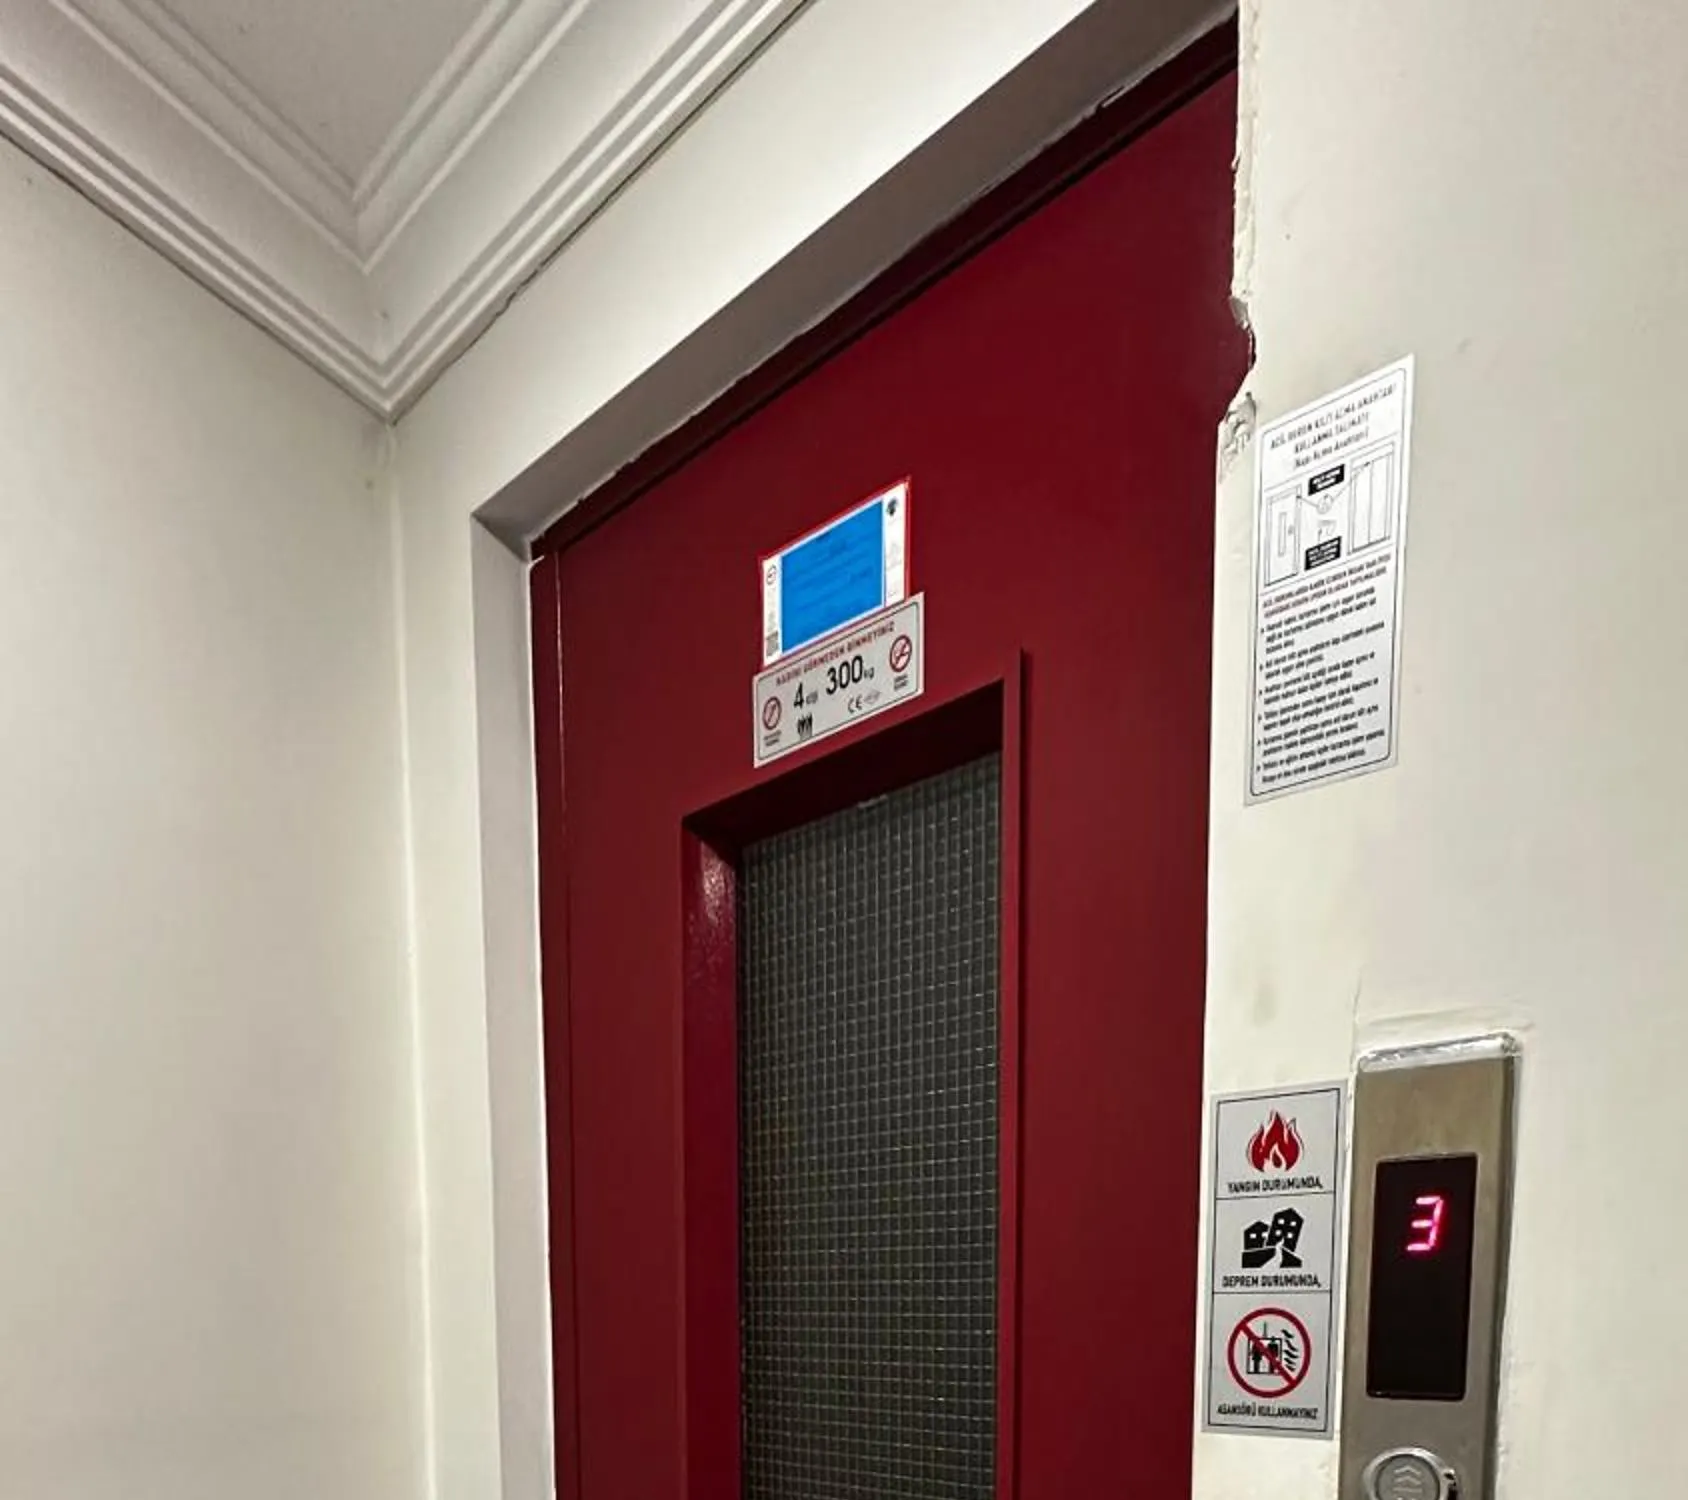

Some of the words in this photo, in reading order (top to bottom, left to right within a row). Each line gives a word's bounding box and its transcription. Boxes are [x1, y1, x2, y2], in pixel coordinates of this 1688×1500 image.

[793, 681, 805, 708] 4
[826, 655, 864, 696] 300
[1227, 1181, 1260, 1194] YANGIN
[1405, 1195, 1444, 1252] 3
[1222, 1275, 1259, 1288] DEPREM
